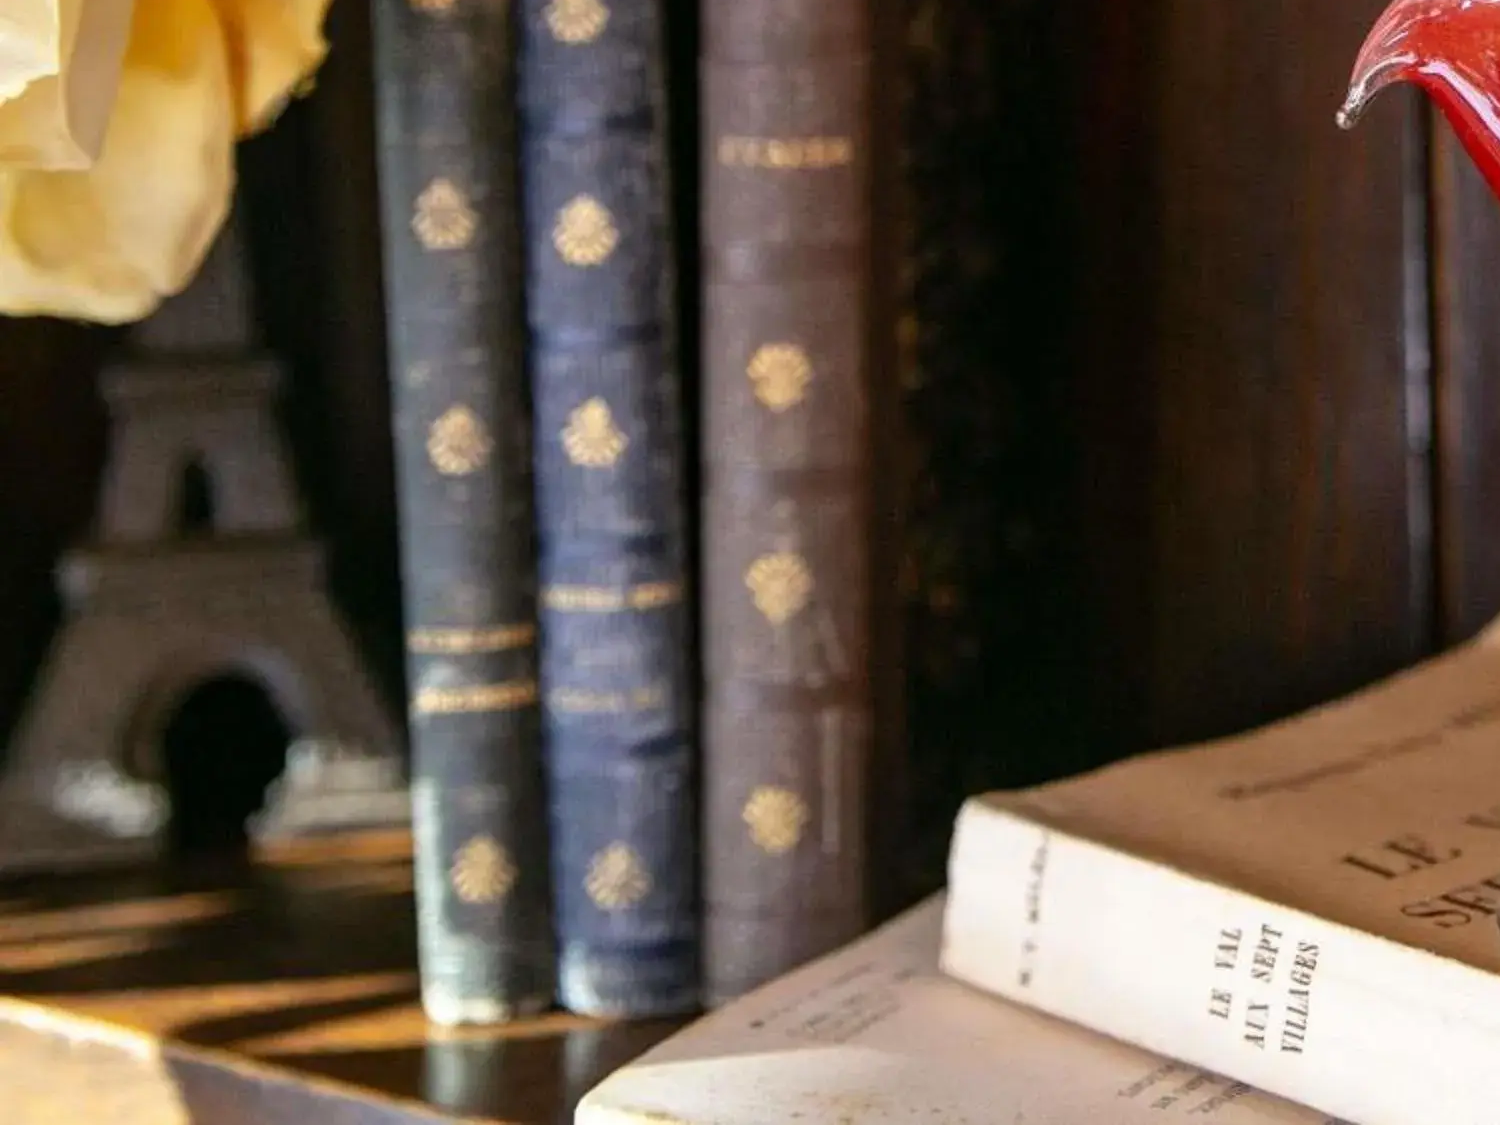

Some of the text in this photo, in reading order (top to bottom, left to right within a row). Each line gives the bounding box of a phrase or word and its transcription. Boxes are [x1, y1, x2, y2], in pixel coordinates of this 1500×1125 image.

[1208, 928, 1243, 1020] LE VAL
[1243, 923, 1283, 1050] AUX SEPT
[1280, 941, 1320, 1054] VILLAGES
